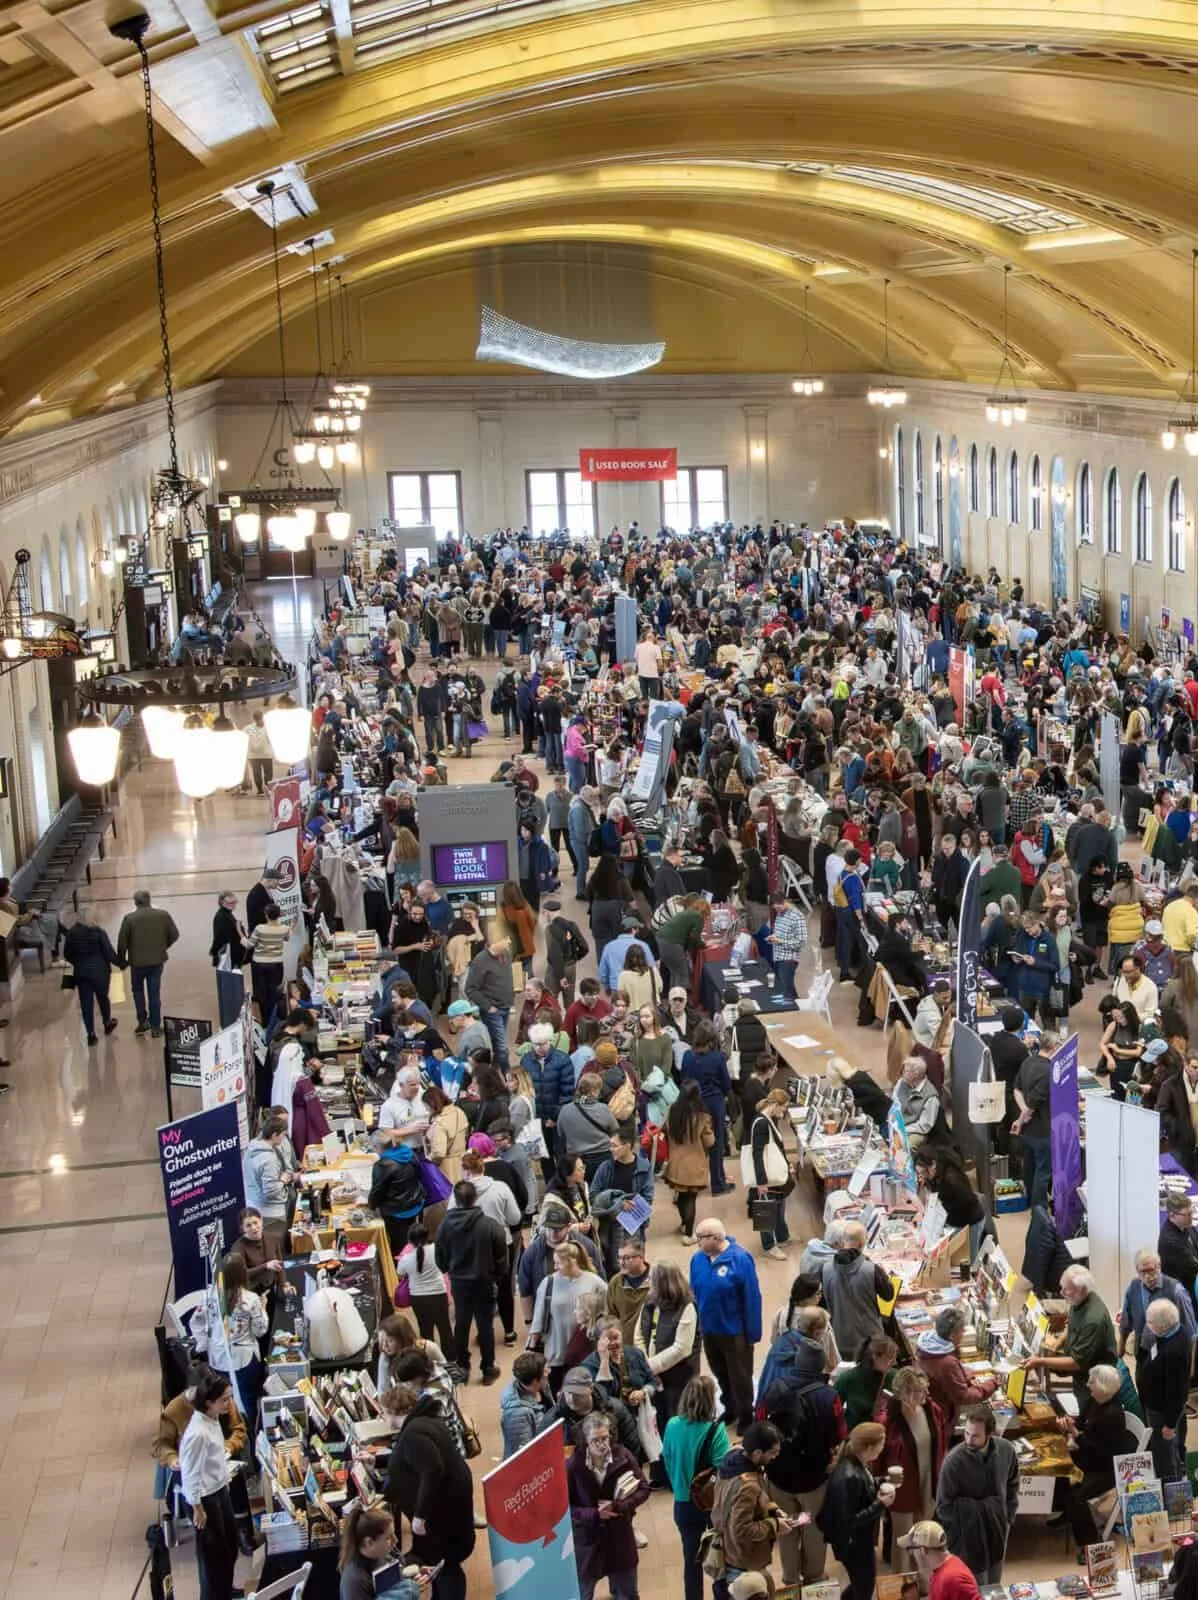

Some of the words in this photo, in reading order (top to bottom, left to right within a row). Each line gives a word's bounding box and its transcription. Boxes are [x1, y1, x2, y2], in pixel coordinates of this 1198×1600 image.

[273, 448, 288, 467] C
[596, 461, 619, 470] USED
[620, 461, 646, 470] BOOK
[648, 461, 669, 470] SALE
[128, 539, 139, 556] B
[454, 851, 473, 859] TWIN
[454, 864, 484, 873] BOOK
[454, 872, 486, 880] FESTIVAL
[161, 1129, 181, 1146] My
[163, 1139, 194, 1159] Own
[165, 1135, 238, 1173] Ghostwriter
[503, 1486, 522, 1512] Red
[521, 1467, 554, 1500] Balloon
